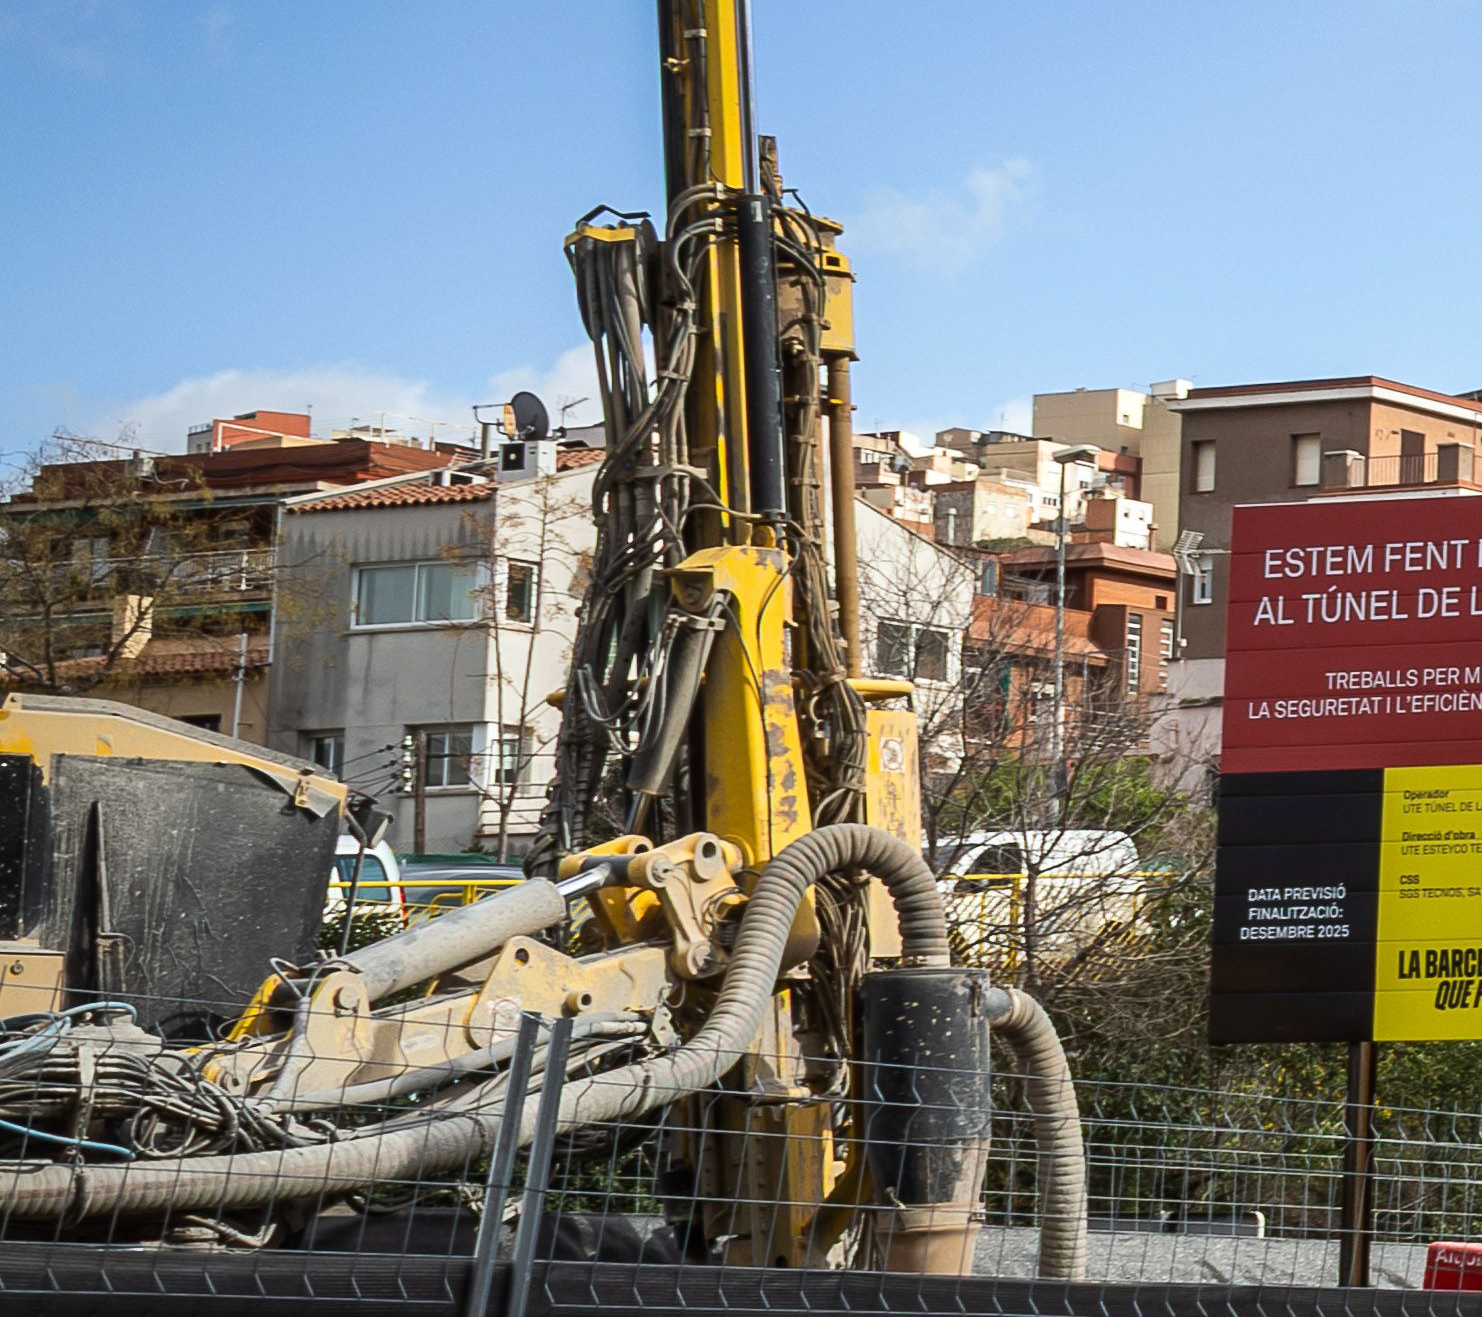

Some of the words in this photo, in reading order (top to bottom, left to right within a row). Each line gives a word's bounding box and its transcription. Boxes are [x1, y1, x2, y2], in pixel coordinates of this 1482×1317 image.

[1264, 544, 1374, 579] ESTEM
[1384, 539, 1470, 573] FENT
[1253, 595, 1295, 626] AL
[1301, 584, 1409, 624] TÚNEL
[1417, 587, 1462, 619] DE
[1325, 668, 1419, 690] TREBALLS
[1422, 667, 1460, 686] PER
[1248, 701, 1271, 720] LA
[1274, 696, 1383, 718] SEGURETAT
[1385, 696, 1391, 714] I
[1403, 789, 1450, 801] Operador
[1403, 803, 1422, 814] UTE
[1424, 800, 1458, 813] TÚNEL
[1460, 801, 1473, 812] DE
[1402, 830, 1442, 842] Direcció
[1401, 845, 1420, 856] UTE
[1423, 843, 1468, 855] ESTEYCO
[1399, 874, 1420, 885] CSS
[1247, 888, 1282, 902] DATA
[1284, 882, 1347, 900] PREVISIÓ
[1399, 888, 1420, 899] SGS
[1421, 887, 1465, 899] TECNOS,
[1467, 886, 1482, 897] SA
[1248, 902, 1344, 921] FINALITZACIÓ:
[1240, 925, 1316, 940] DESEMBRE
[1317, 924, 1351, 938] 2025
[1398, 949, 1421, 979] LA
[1434, 979, 1476, 1011] QUE
